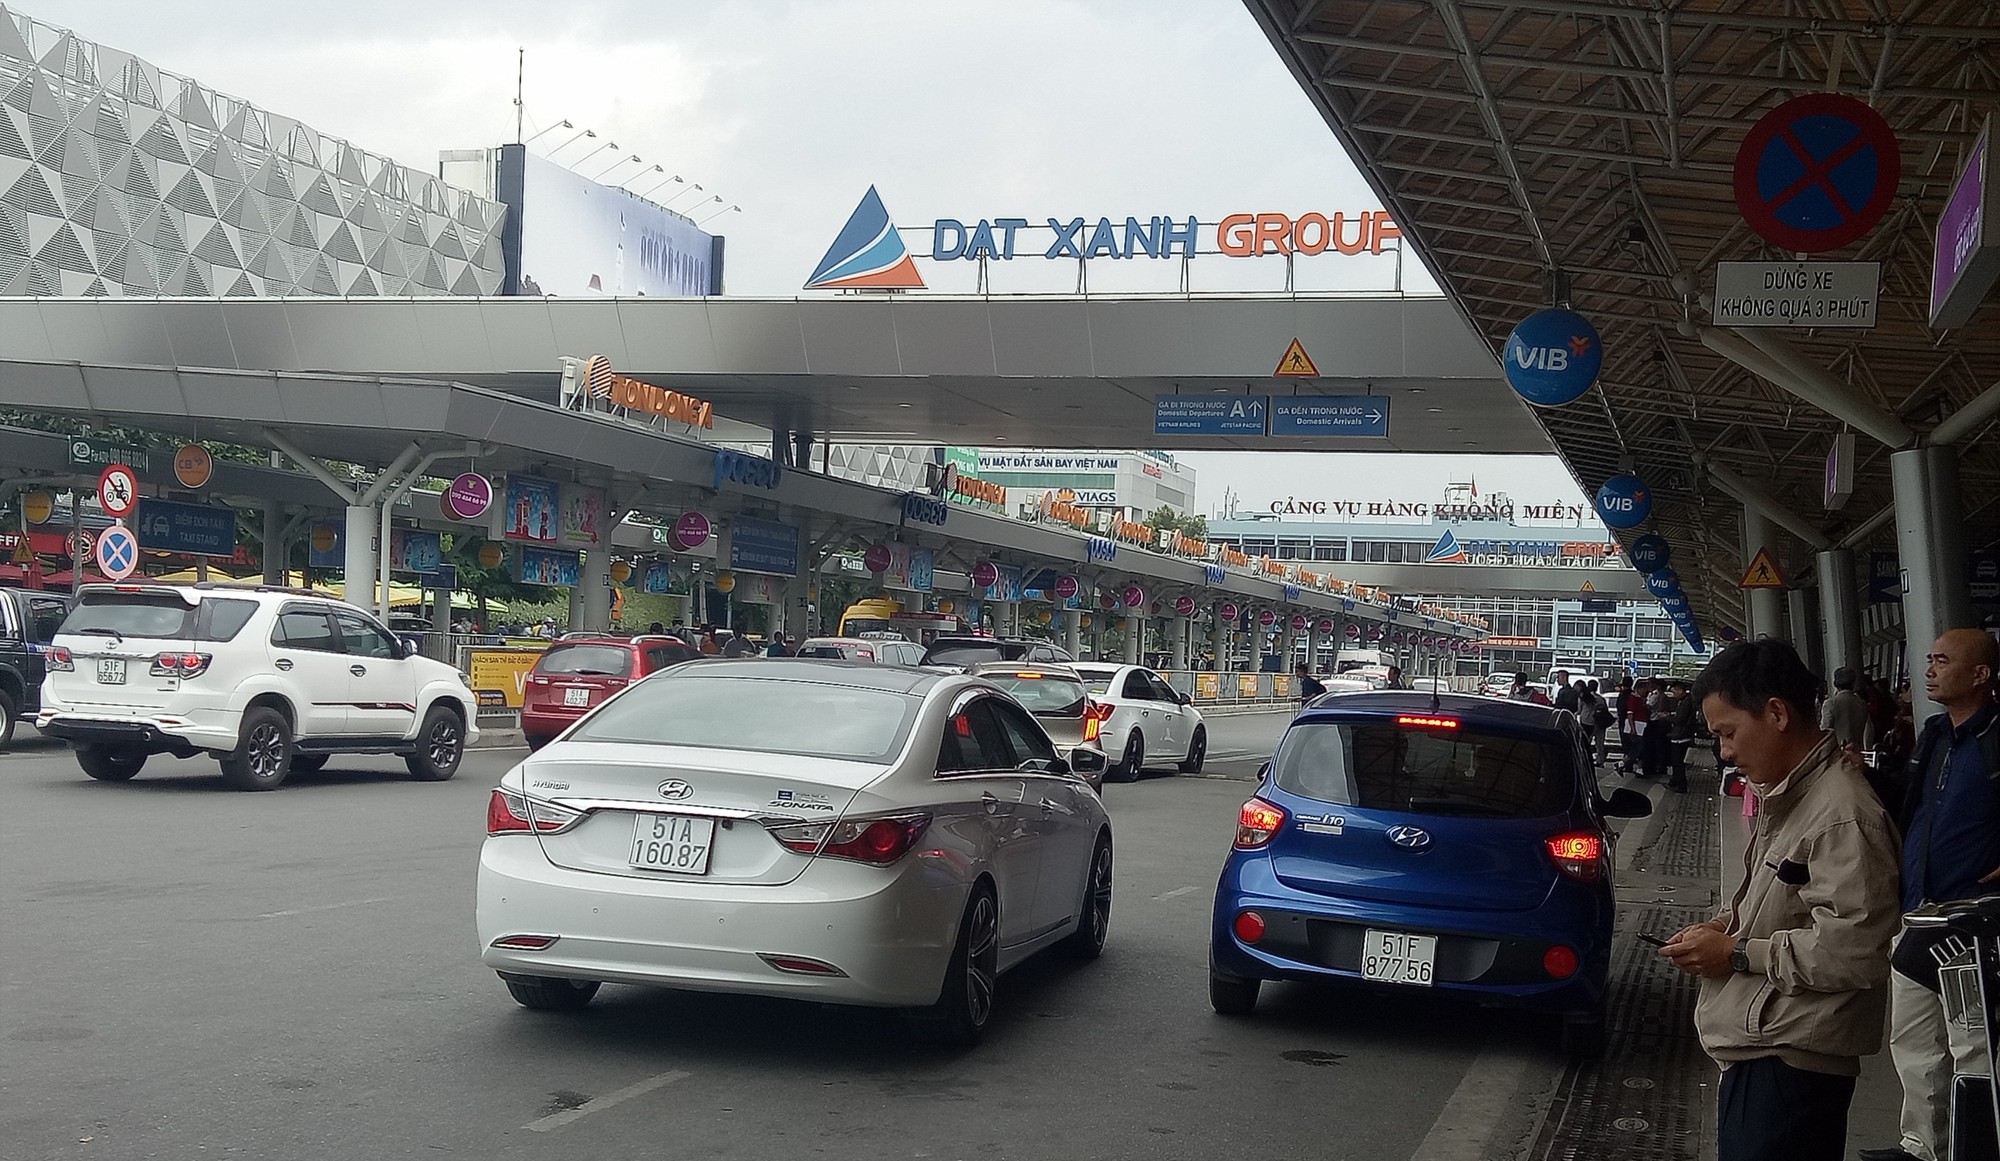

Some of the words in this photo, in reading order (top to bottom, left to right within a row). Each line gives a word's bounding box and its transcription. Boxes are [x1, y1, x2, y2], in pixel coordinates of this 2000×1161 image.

[932, 218, 1027, 261] DAT
[1045, 215, 1198, 260] XANH
[1764, 266, 1808, 290] DỪNG
[1812, 271, 1834, 290] XE
[1720, 294, 1775, 317] KHÔNG
[1779, 296, 1812, 319] QUÁ
[1815, 301, 1824, 318] 3
[1828, 297, 1870, 318] PHÚT
[1516, 346, 1568, 371] VIB
[1189, 410, 1224, 418] Departures
[1229, 400, 1246, 418] A
[1310, 407, 1338, 415] TRONG
[1055, 459, 1073, 468] BAY
[1097, 459, 1118, 468] NAM
[1077, 492, 1116, 502] VIAGS
[1603, 496, 1634, 512] VIB
[1270, 496, 1326, 515] CẢNG
[1333, 500, 1361, 517] VỤ
[1367, 497, 1427, 517] HÀNG
[1433, 498, 1515, 519] KHÔNG
[1634, 550, 1657, 561] VIB
[1651, 579, 1669, 588] VIB
[1665, 598, 1680, 606] VIB
[104, 660, 119, 671] 51F
[532, 779, 570, 791] HYUNDAI
[768, 801, 834, 811] SONATA
[652, 815, 693, 843] 51A
[635, 840, 706, 869] 160.87
[1382, 935, 1419, 958] 51F
[1366, 956, 1431, 982] 877.56
